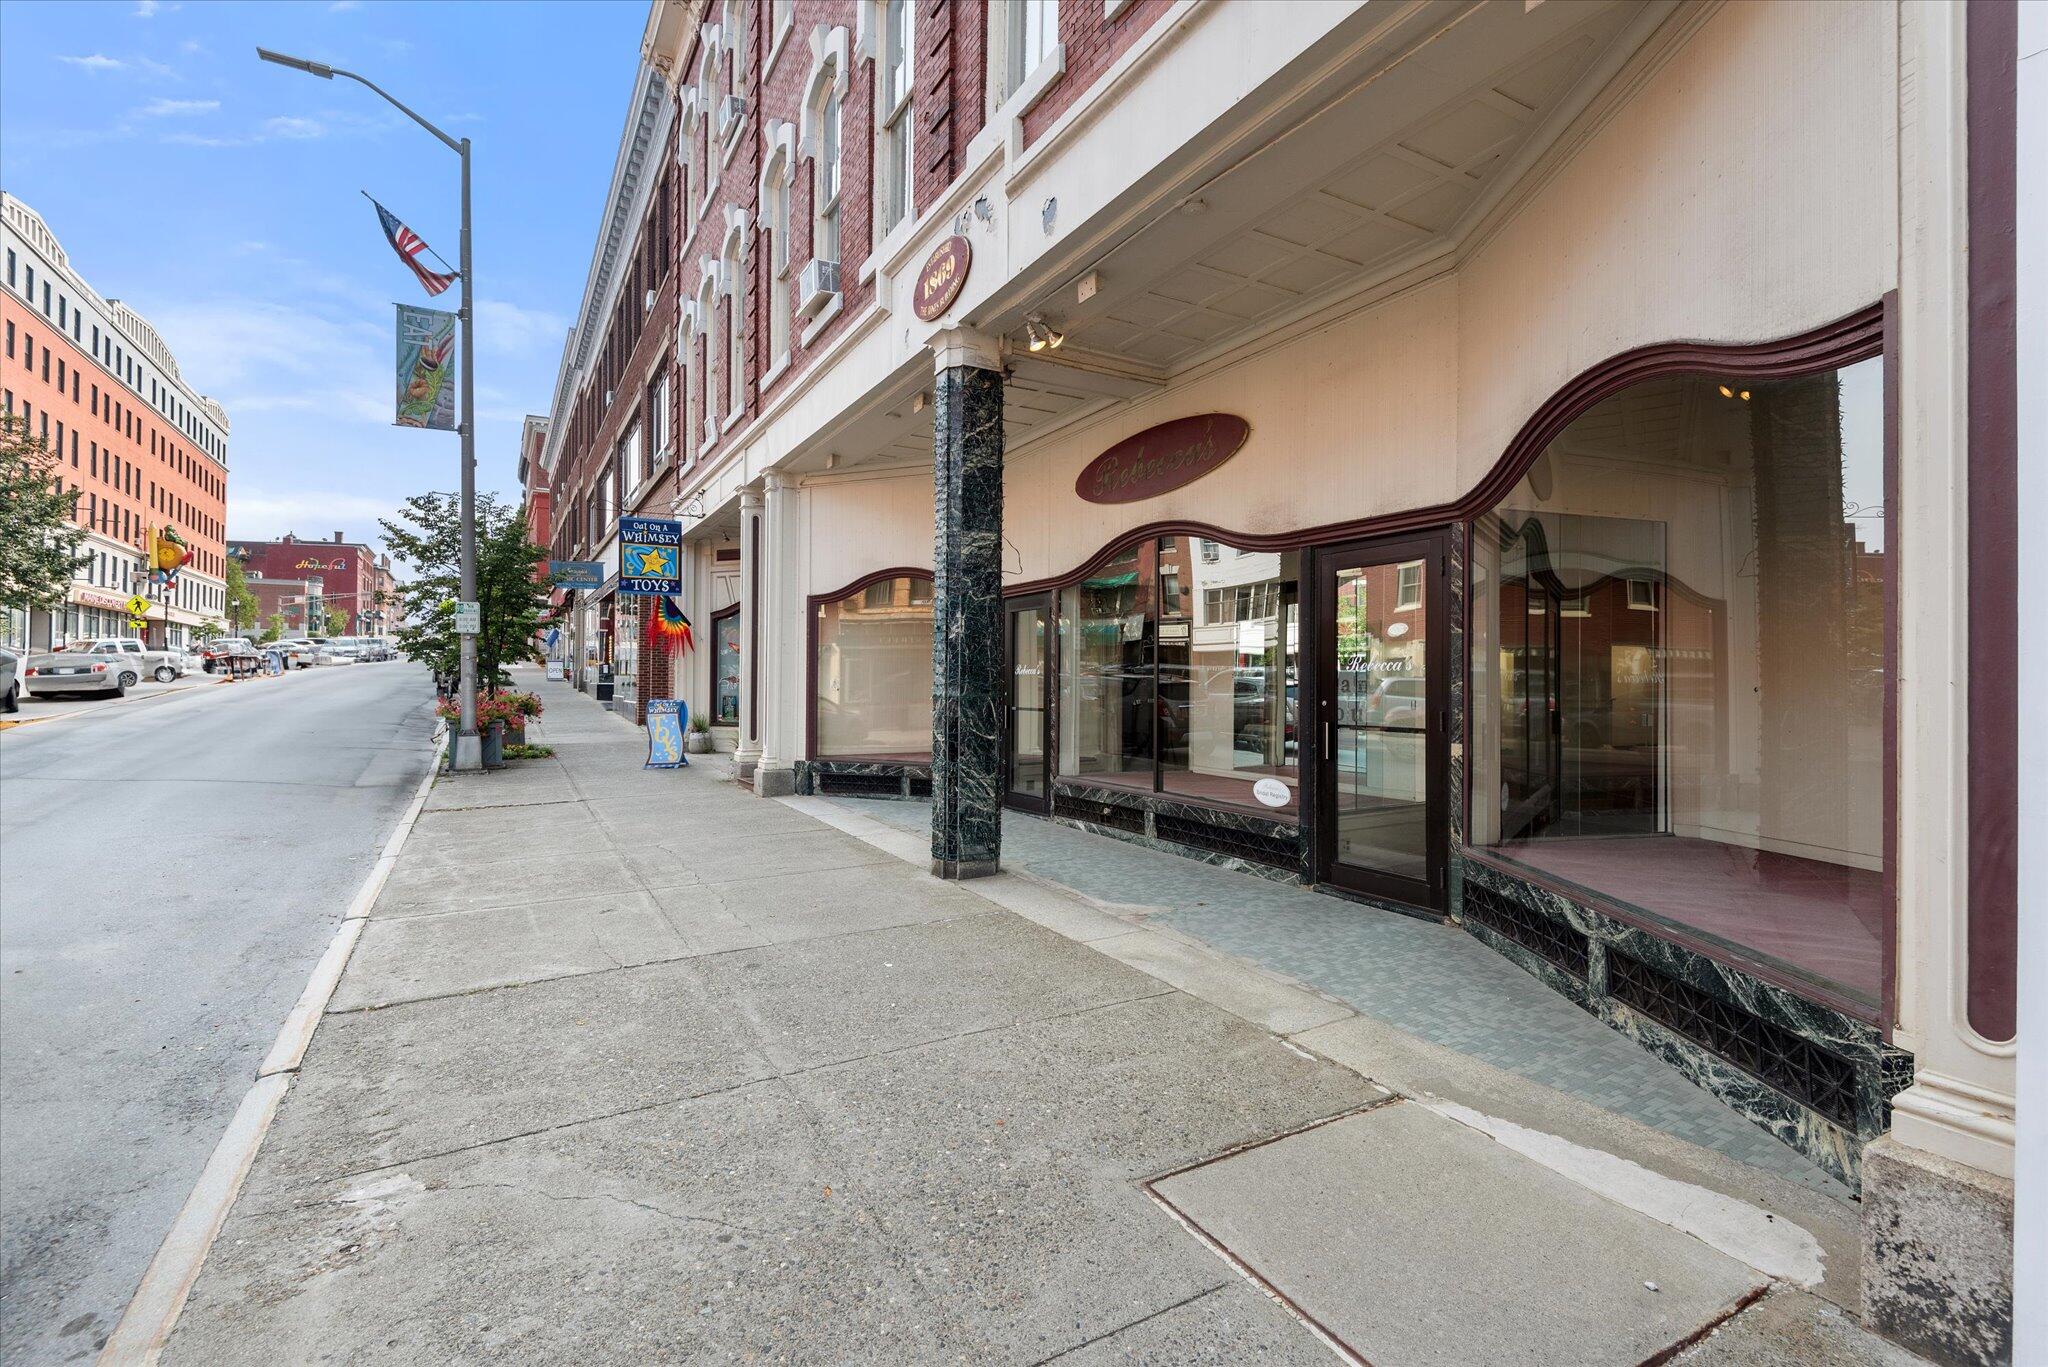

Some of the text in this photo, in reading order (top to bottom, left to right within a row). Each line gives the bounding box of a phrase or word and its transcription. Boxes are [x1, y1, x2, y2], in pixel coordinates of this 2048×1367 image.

[924, 254, 956, 300] 1869
[403, 311, 433, 351] EAT
[649, 523, 662, 532] On
[662, 524, 669, 532] A
[295, 557, 347, 571] Hopeful
[631, 578, 670, 592] TOYS
[548, 666, 564, 674] OPEN
[1346, 654, 1413, 672] Rebecca's
